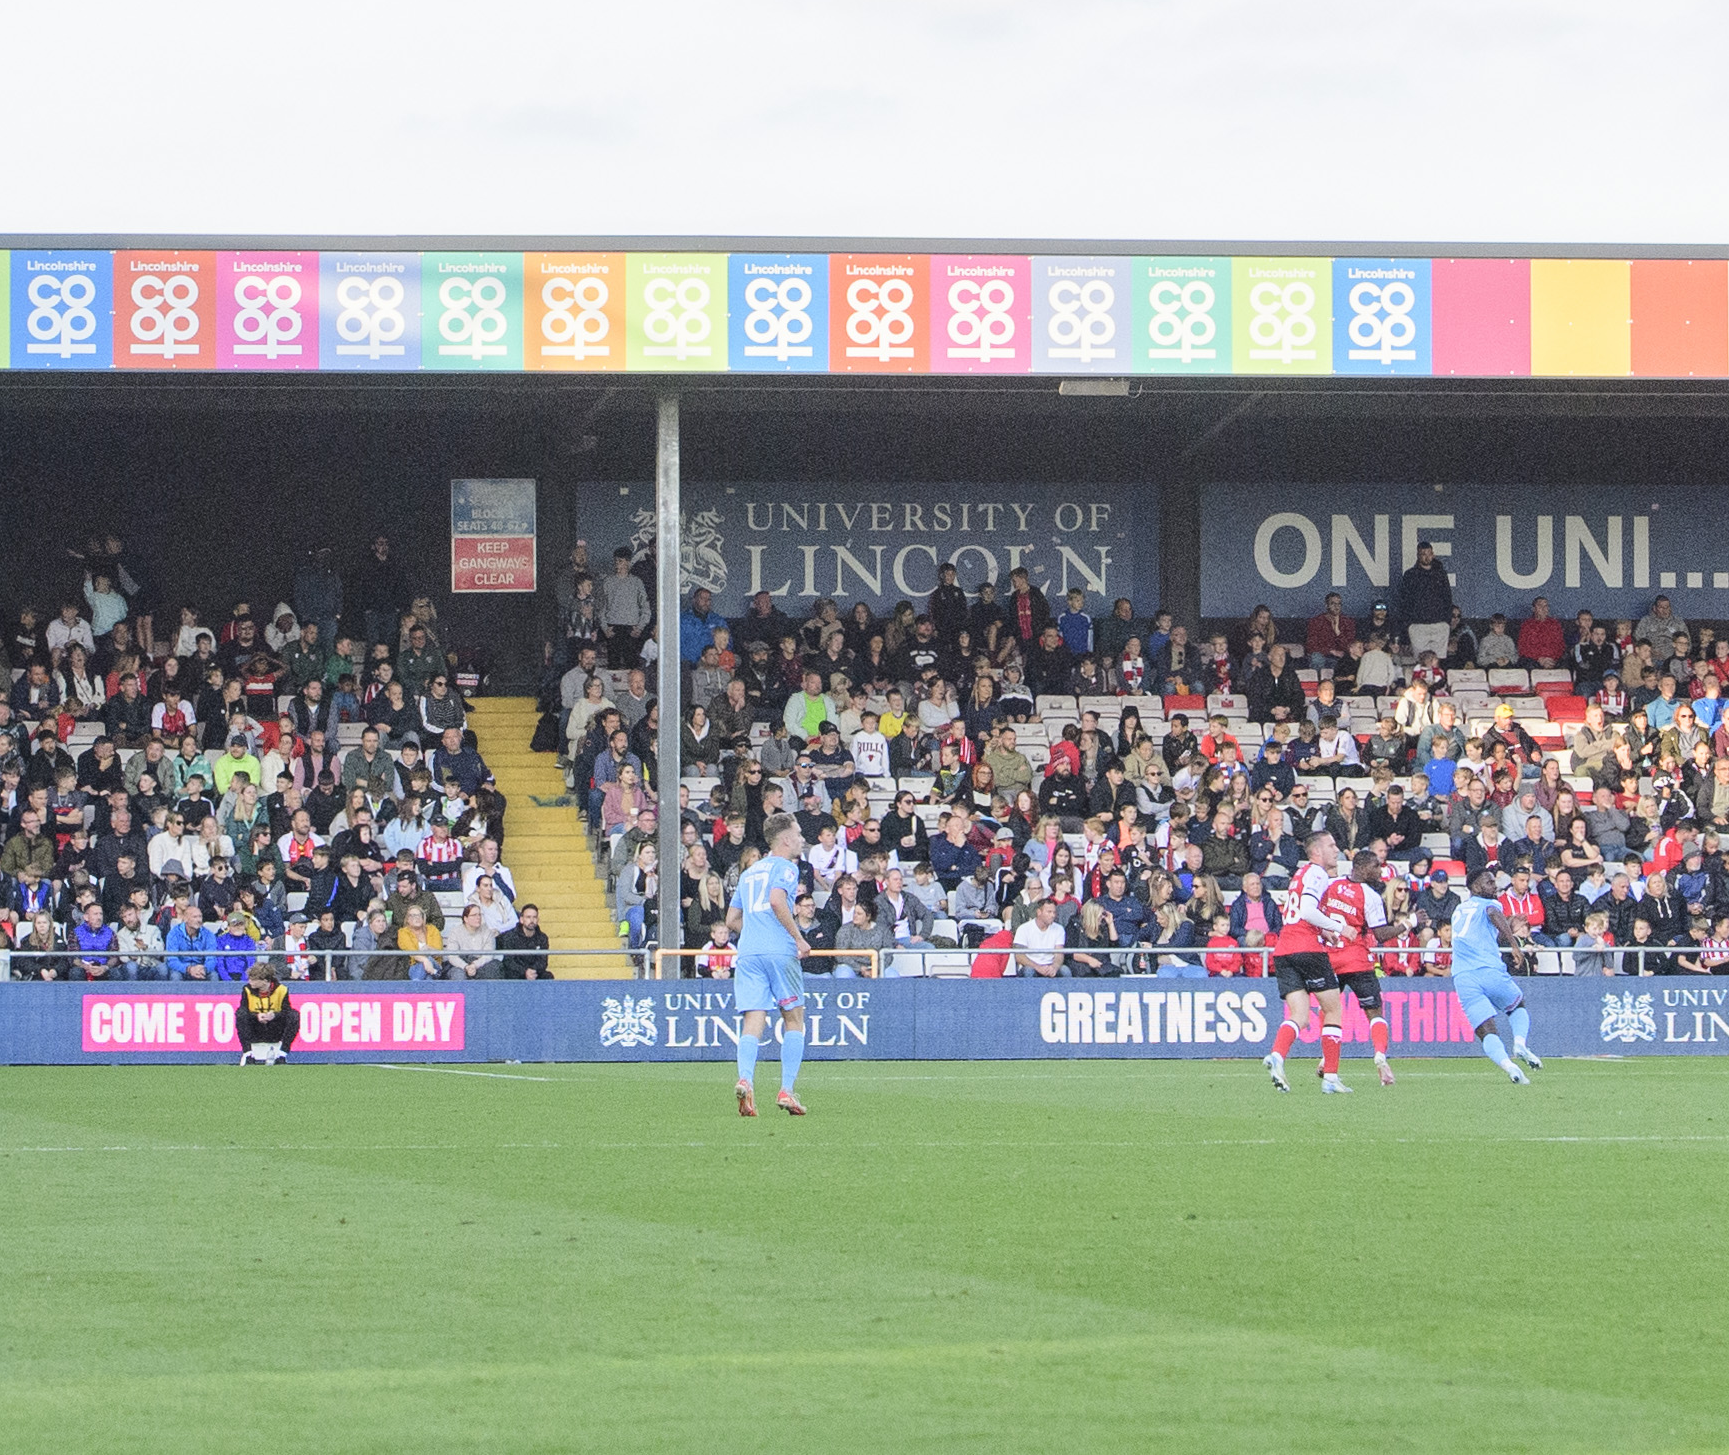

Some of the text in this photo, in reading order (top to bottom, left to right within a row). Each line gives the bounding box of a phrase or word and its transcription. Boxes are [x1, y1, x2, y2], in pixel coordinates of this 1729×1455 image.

[26, 260, 97, 272] Lincolnshire
[130, 260, 200, 272] Lincolnshire
[233, 261, 303, 273] Lincolnshire
[336, 262, 405, 273] Lincolnshire
[438, 262, 507, 273] Lincolnshire
[540, 263, 610, 275] Lincolnshire
[643, 264, 711, 275] Lincolnshire
[744, 263, 813, 275] Lincolnshire
[846, 264, 915, 276] Lincolnshire
[947, 265, 1015, 277] Lincolnshire
[1047, 266, 1116, 277] Lincolnshire
[1148, 266, 1216, 278] Lincolnshire
[1248, 268, 1316, 279] Lincolnshire
[1348, 268, 1416, 280] Lincolnshire
[746, 503, 1112, 531] UNIVERSITY OF
[457, 521, 487, 531] SEATS
[477, 542, 509, 553] KEEP
[1253, 512, 1729, 589] ONE UNI...
[459, 558, 529, 569] GANGWAYS
[744, 544, 1112, 597] LINCOLN
[475, 573, 514, 585] CLEAR
[744, 872, 771, 913] 12
[837, 992, 870, 1009] OF
[90, 1001, 455, 1044] COME TO OPEN DAY
[1041, 991, 1267, 1044] GREATNESS
